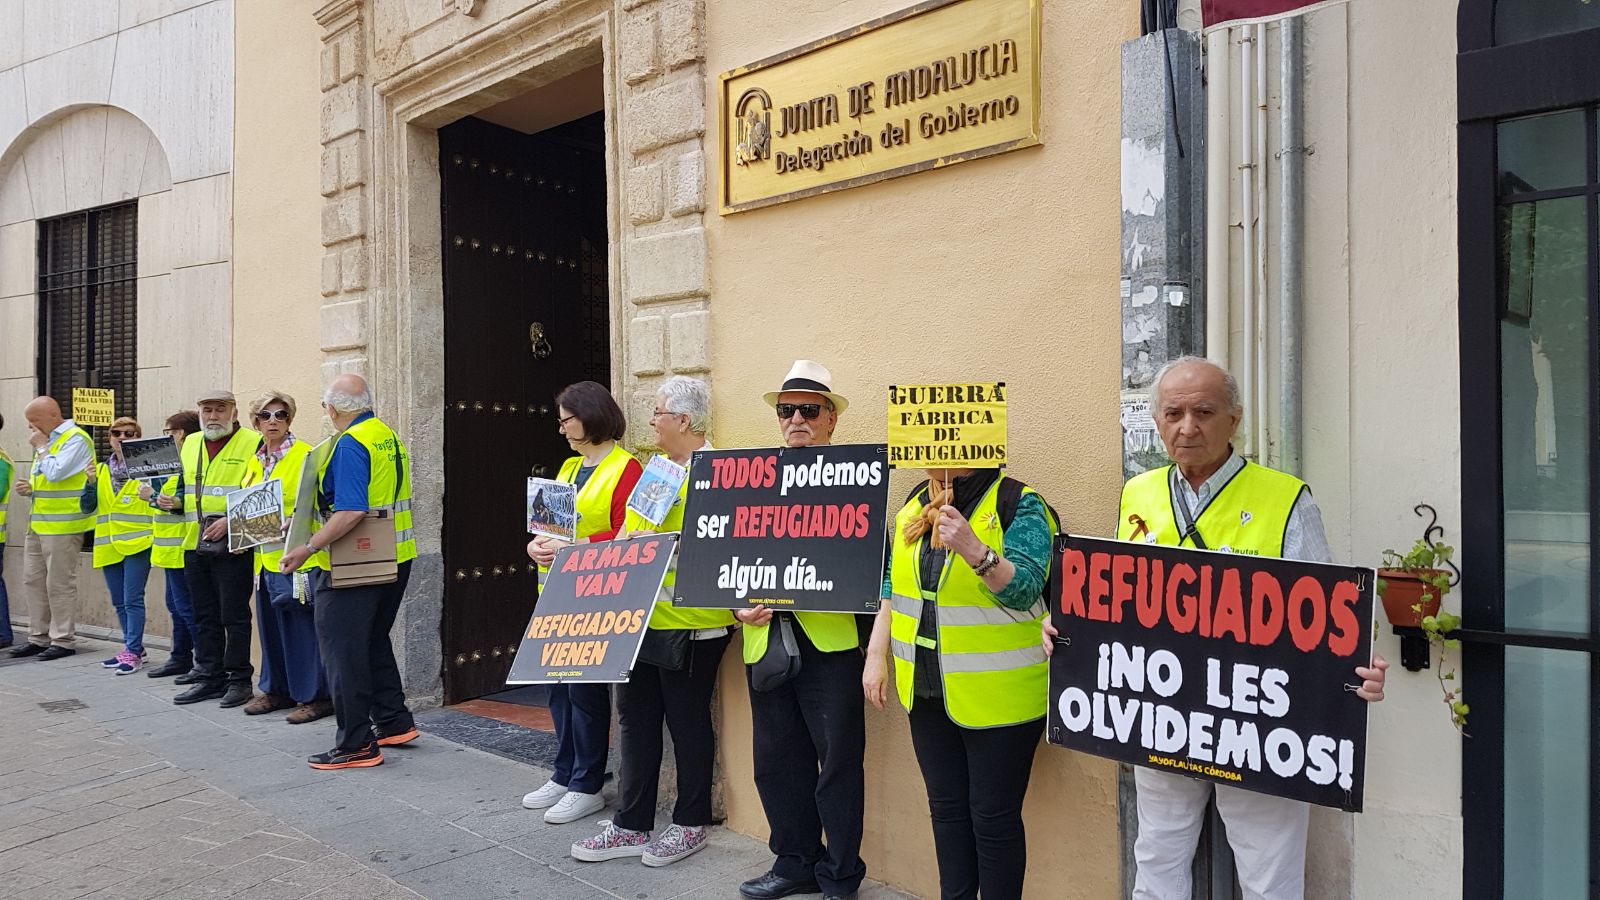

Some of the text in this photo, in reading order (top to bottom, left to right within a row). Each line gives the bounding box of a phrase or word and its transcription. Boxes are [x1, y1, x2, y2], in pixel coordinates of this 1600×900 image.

[776, 93, 839, 138] JUNTA
[848, 81, 876, 118] DE
[775, 95, 1019, 174] Delegación del Gobierno
[79, 389, 108, 397] MARES
[890, 385, 1005, 405] GUERRA
[75, 414, 112, 423] MUERTE
[900, 409, 994, 426] FÁBRICA
[933, 427, 960, 441] DE
[890, 444, 1006, 461] REFUGIADOS
[780, 454, 882, 496] podemos
[696, 503, 870, 539] ser REFUGIADOS
[560, 540, 659, 574] ARMAS
[575, 571, 628, 598] VAN
[717, 556, 833, 599] algún día...
[1060, 548, 1360, 657] REFUGIADOS
[527, 608, 646, 640] REFUGIADOS
[540, 640, 609, 667] VIENEN
[1097, 641, 1290, 718] ¡NO LES
[1058, 686, 1354, 791] OLVIDEMOS!
[1148, 754, 1242, 781] YAYOFLAUTAS CÓRDOBA
